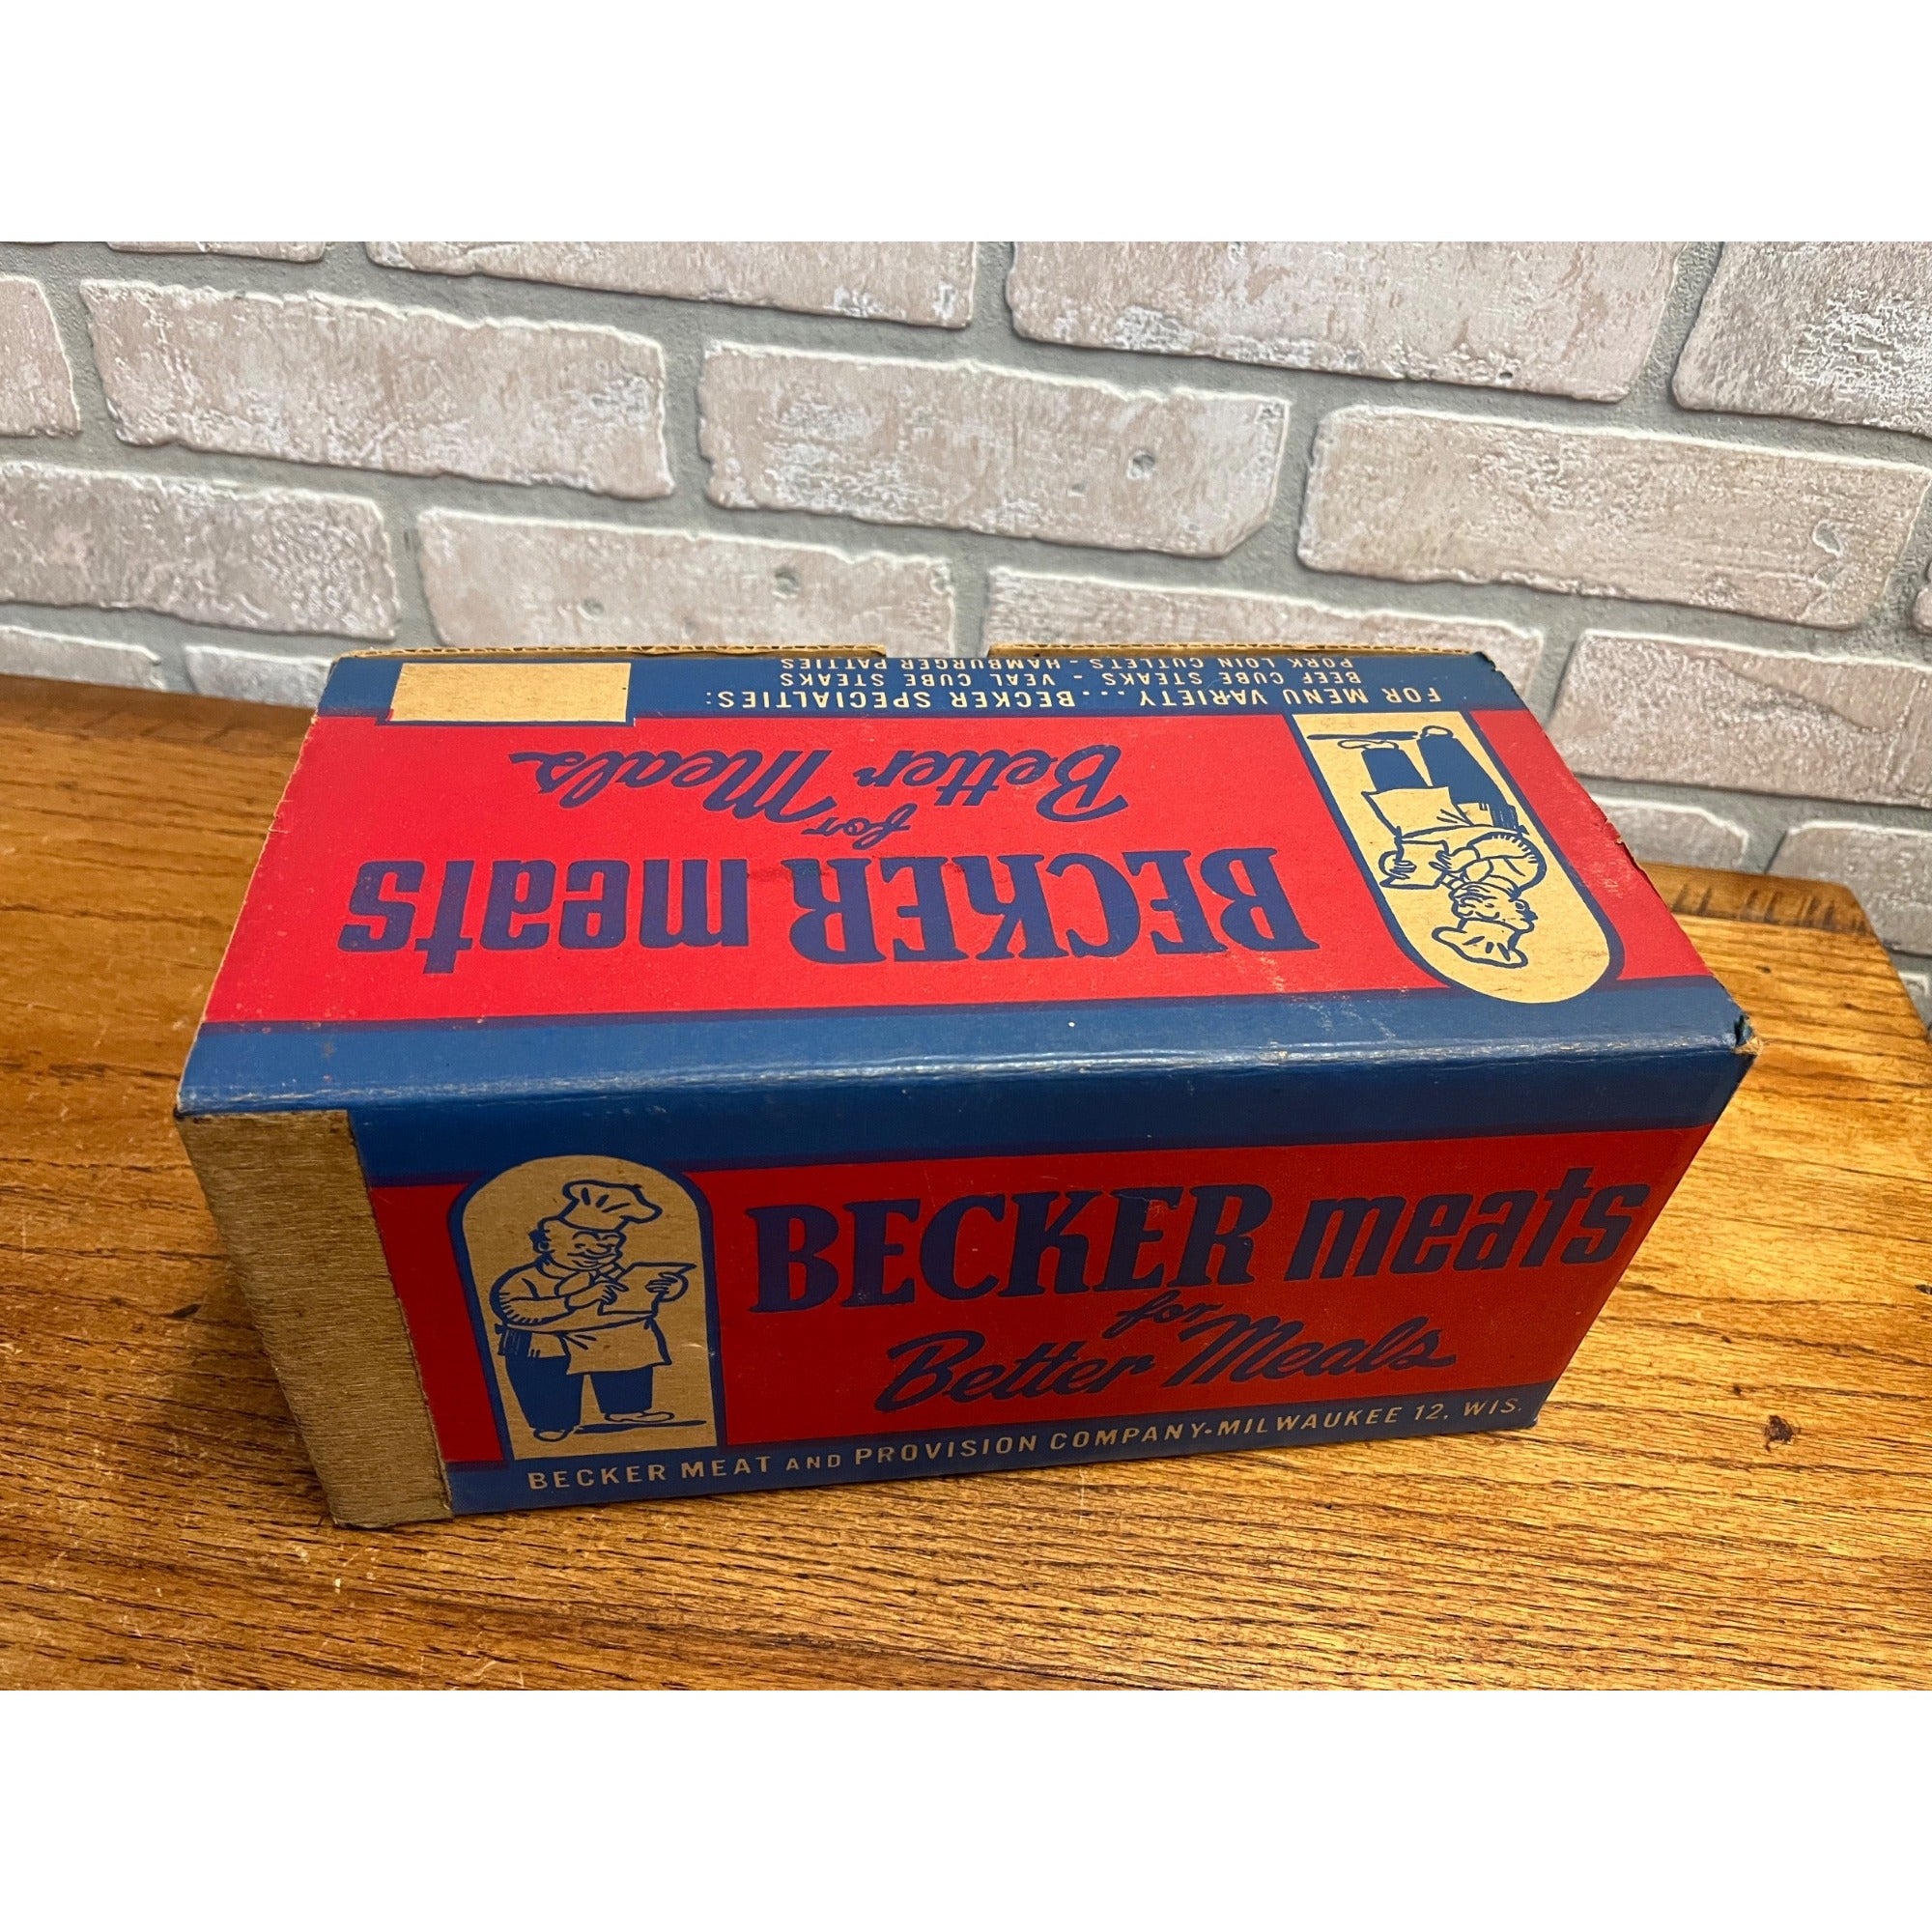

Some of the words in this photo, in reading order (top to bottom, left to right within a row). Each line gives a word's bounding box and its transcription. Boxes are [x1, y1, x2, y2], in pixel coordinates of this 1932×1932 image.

[781, 658, 888, 670] PATTIES
[900, 658, 1062, 669] HAMBURGER
[1090, 658, 1205, 669] CUTLETS
[1219, 658, 1276, 669] LOIN
[1287, 657, 1353, 668] PORK
[780, 673, 885, 687] STEAKS
[904, 673, 972, 687] CUBE
[989, 673, 1056, 687] VEAL
[1102, 672, 1203, 686] STEAKS
[1222, 671, 1285, 685] CUBE
[1302, 671, 1362, 684] BEEF
[705, 691, 932, 709] SPECIALTIES:
[951, 691, 1076, 708] BECKER
[1283, 688, 1370, 705] MENU
[1384, 687, 1442, 703] FOR
[508, 750, 834, 823] Meals
[853, 744, 1128, 822] Better
[801, 803, 919, 850] for
[781, 847, 1321, 964] BECKER
[337, 858, 750, 975] meats
[745, 1183, 1273, 1314] BECKER
[1283, 1167, 1651, 1282] meats
[1100, 1290, 1222, 1340] for
[873, 1329, 1156, 1414] Better
[1160, 1314, 1457, 1389] Meals
[527, 1463, 668, 1491] BECKER
[680, 1456, 772, 1479] MEAT
[785, 1453, 842, 1472] AND
[854, 1435, 1037, 1466] PROVISION
[1463, 1397, 1523, 1417] WIS.
